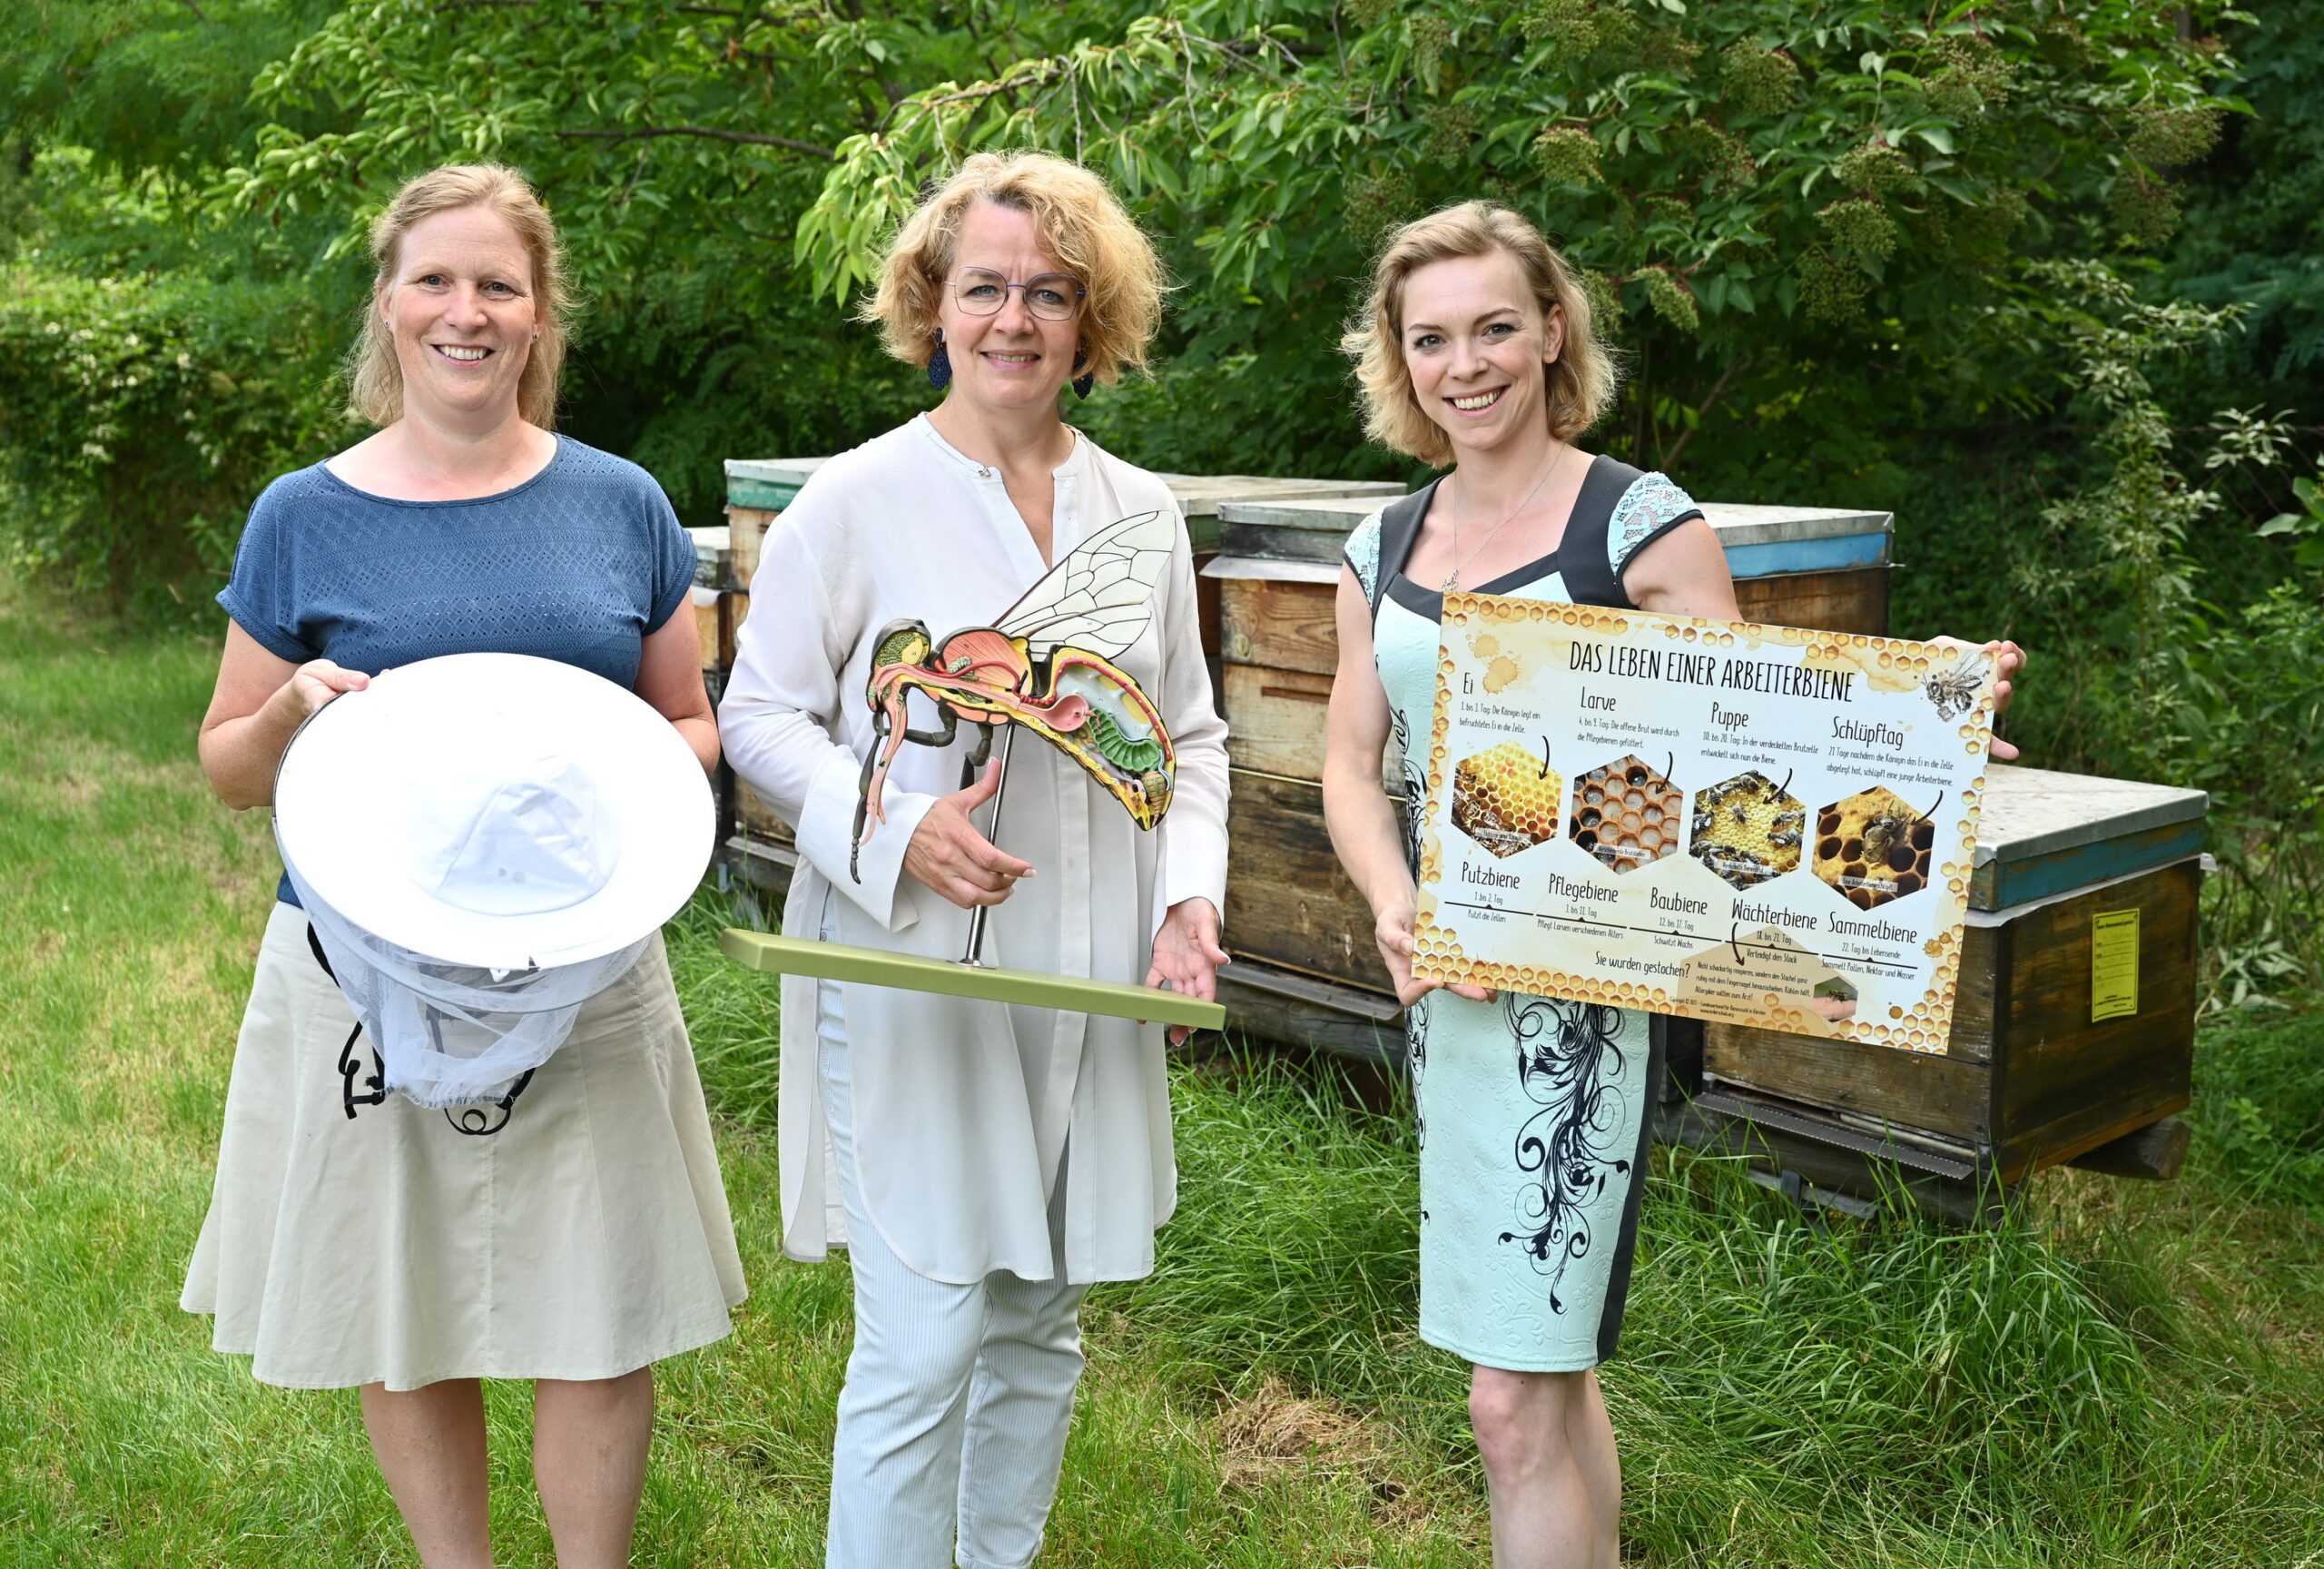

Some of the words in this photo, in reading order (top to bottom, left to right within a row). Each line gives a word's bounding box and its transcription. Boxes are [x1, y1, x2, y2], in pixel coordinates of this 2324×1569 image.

[1570, 640, 1603, 673] DAS
[1608, 645, 1661, 680] LEBEN
[1666, 652, 1717, 686] EINER
[1720, 658, 1856, 703] ARBEITERBIENE
[1462, 672, 1473, 695] Ei
[1581, 686, 1617, 712] Larve
[1465, 702, 1474, 712] bis
[1480, 703, 1492, 716] Tag:
[1492, 705, 1501, 715] Die
[1501, 706, 1521, 719] Königin
[1521, 709, 1532, 721] legt
[1710, 701, 1749, 733] Puppe
[1459, 716, 1491, 729] befruchtetes
[1502, 722, 1512, 732] die
[1512, 722, 1526, 734] Zelle.
[1584, 717, 1592, 727] bis
[1599, 717, 1610, 731] Tag:
[1610, 719, 1620, 730] Die
[1620, 721, 1638, 733] offene
[1637, 722, 1649, 734] Brut
[1650, 726, 1664, 735] wird
[1663, 726, 1680, 737] durch
[1831, 715, 1904, 752] Schlüpftag
[1576, 732, 1585, 742] die
[1585, 732, 1619, 745] Pflegebienen
[1619, 737, 1644, 749] gefüttert.
[1702, 730, 1710, 742] 10.
[1710, 732, 1719, 743] bis
[1719, 732, 1728, 744] 20.
[1729, 733, 1741, 747] Tag:
[1748, 736, 1759, 747] der
[1758, 739, 1793, 751] verdeckelten
[1793, 741, 1819, 755] Brutzelle
[1700, 747, 1728, 759] entwickelt
[1728, 751, 1740, 760] sich
[1739, 754, 1752, 762] nun
[1751, 754, 1760, 763] die
[1760, 753, 1776, 765] Biene.
[1837, 746, 1850, 760] Tage
[1849, 750, 1876, 761] nachdem
[1876, 753, 1885, 763] die
[1885, 753, 1906, 766] Königin
[1906, 756, 1917, 766] das
[1930, 758, 1940, 769] die
[1939, 759, 1955, 771] Zelle
[1826, 763, 1851, 776] abgelegt
[1850, 765, 1863, 776] hat,
[1863, 767, 1886, 780] schlüpft
[1886, 772, 1898, 780] eine
[1897, 773, 1915, 784] junge
[1915, 772, 1953, 786] Arbeiterbiene.
[1461, 861, 1521, 890] Putzbiene
[1548, 873, 1619, 903] Pflegebiene
[1493, 893, 1503, 906] Tag
[1649, 886, 1709, 915] Baubiene
[1467, 908, 1482, 920] Putzt
[1482, 912, 1491, 921] die
[1490, 912, 1507, 923] Zellen
[1570, 905, 1579, 915] bis
[1579, 905, 1587, 916] 11.
[1588, 906, 1598, 920] Tag
[1731, 897, 1817, 931] Wächterbiene
[1537, 918, 1553, 932] Pflegt
[1553, 921, 1571, 932] Larven
[1571, 926, 1607, 937] verschiedenen
[1607, 928, 1624, 940] Alters
[1659, 916, 1667, 927] 12.
[1667, 918, 1676, 928] bis
[1684, 919, 1695, 933] Tag
[1827, 911, 1917, 944] Sammelbiene
[1653, 934, 1677, 947] Schwitzt
[1677, 938, 1694, 950] Wachs
[1764, 932, 1772, 942] bis
[1772, 932, 1781, 942] 21.
[1781, 933, 1792, 946] Tag
[1746, 947, 1772, 962] Verteidigt
[1771, 952, 1783, 962] den
[1783, 952, 1797, 964] Stock
[1841, 942, 1849, 952] 22.
[1851, 942, 1861, 956] Tag
[1861, 945, 1870, 955] bis
[1870, 945, 1901, 960] Lebensende
[1594, 950, 1608, 967] Sie
[1609, 956, 1642, 972] wurden
[1643, 961, 1691, 979] gestochen?
[1697, 961, 1709, 970] Nicht
[1709, 963, 1733, 975] schockartig
[1732, 968, 1755, 977] reagieren,
[1754, 971, 1772, 979] sondern
[1780, 972, 1797, 982] Stachel
[1796, 977, 1808, 985] ganz
[1820, 958, 1846, 971] Sammelt
[1846, 962, 1866, 974] Pollen,
[1866, 964, 1885, 976] Nektar
[1885, 969, 1896, 978] und
[1896, 969, 1915, 981] Wasser
[1694, 985, 1716, 996] Allergiker
[1716, 990, 1731, 998] sollten
[1741, 992, 1754, 1002] Arzt!
[1695, 974, 1709, 984] ruhig
[1726, 977, 1751, 990] Fingernagel
[1784, 985, 1800, 995] Kühlen
